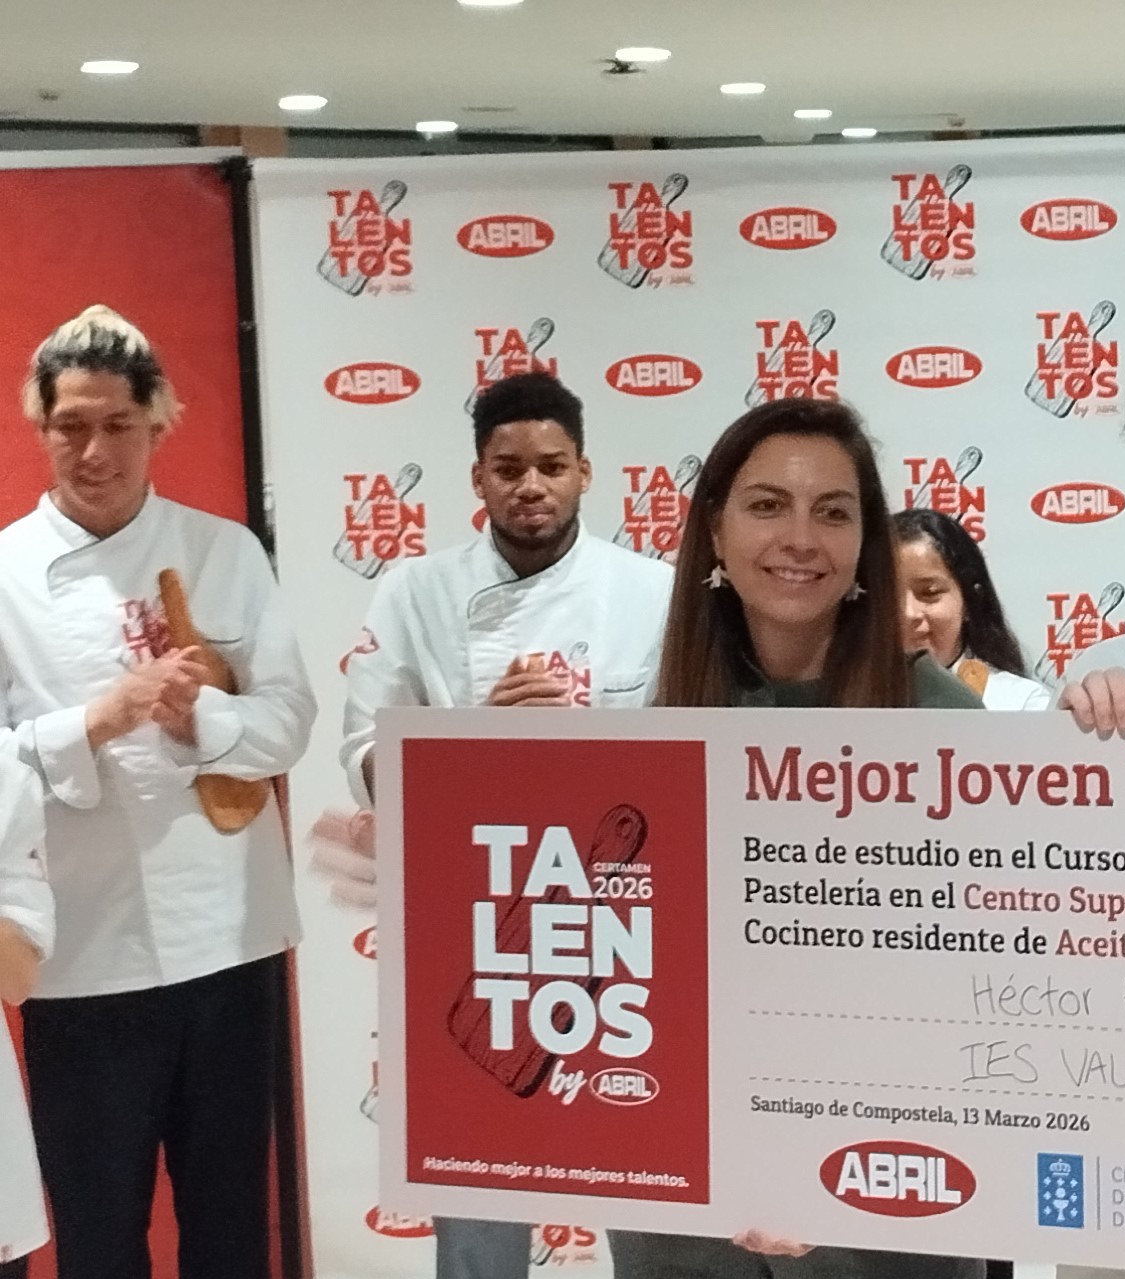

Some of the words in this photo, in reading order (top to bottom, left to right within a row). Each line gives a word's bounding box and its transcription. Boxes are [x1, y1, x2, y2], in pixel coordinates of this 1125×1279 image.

[608, 182, 664, 209] TA
[891, 173, 946, 200] TA
[327, 189, 380, 217] TA
[893, 202, 975, 231] LEN
[329, 218, 412, 247] LEN
[610, 210, 692, 240] LEN
[751, 214, 829, 241] ABRIL
[1031, 204, 1109, 232] ABRIL
[468, 222, 547, 250] ABRIL
[894, 232, 976, 261] TOS
[331, 248, 413, 278] TOS
[611, 241, 693, 270] TOS
[755, 320, 810, 348] TA
[1036, 312, 1089, 339] TA
[475, 328, 528, 355] TA
[1037, 341, 1118, 369] LEN
[616, 361, 694, 388] ABRIL
[757, 349, 839, 379] LEN
[897, 353, 975, 380] ABRIL
[335, 369, 412, 396] ABRIL
[1038, 371, 1119, 400] TOS
[622, 466, 677, 493] TA
[903, 458, 957, 484] TA
[344, 474, 397, 501] TA
[345, 502, 425, 531] LEN
[1041, 489, 1119, 516] ABRIL
[347, 533, 427, 561] TOS
[1046, 593, 1099, 620] TA
[744, 745, 919, 818] Mejor
[926, 748, 1114, 820] Joven
[472, 824, 594, 898] TA
[743, 836, 808, 864] Beca
[815, 838, 847, 865] de
[855, 839, 960, 868] estudio
[968, 849, 1003, 868] en
[1011, 842, 1037, 869] el
[593, 862, 652, 875] CERTAMEN
[593, 877, 653, 900] 2026
[743, 877, 881, 907] Pastelería
[888, 889, 924, 908] en
[931, 882, 957, 909] el
[963, 883, 1061, 912] Centro
[472, 901, 653, 978] LEN
[744, 918, 864, 948] Cocinero
[872, 923, 1005, 953] residente
[1013, 926, 1048, 955] de
[971, 973, 1092, 1018] Héctor
[473, 977, 654, 1058] TOS
[960, 1040, 1039, 1084] IES
[549, 1060, 587, 1105] by
[597, 1074, 653, 1099] ABRIL
[750, 1094, 824, 1119] Santiago
[828, 1098, 849, 1116] de
[853, 1101, 959, 1126] Compostela,
[963, 1108, 980, 1125] 13
[984, 1110, 1041, 1128] Marzo
[1045, 1113, 1091, 1132] 2026
[423, 1156, 489, 1174] Haciendo
[490, 1162, 532, 1179] mejor
[533, 1166, 543, 1178] a
[545, 1164, 566, 1179] los
[569, 1168, 625, 1184] mejores
[627, 1171, 690, 1188] talentos.
[835, 1151, 962, 1205] ABRIL
